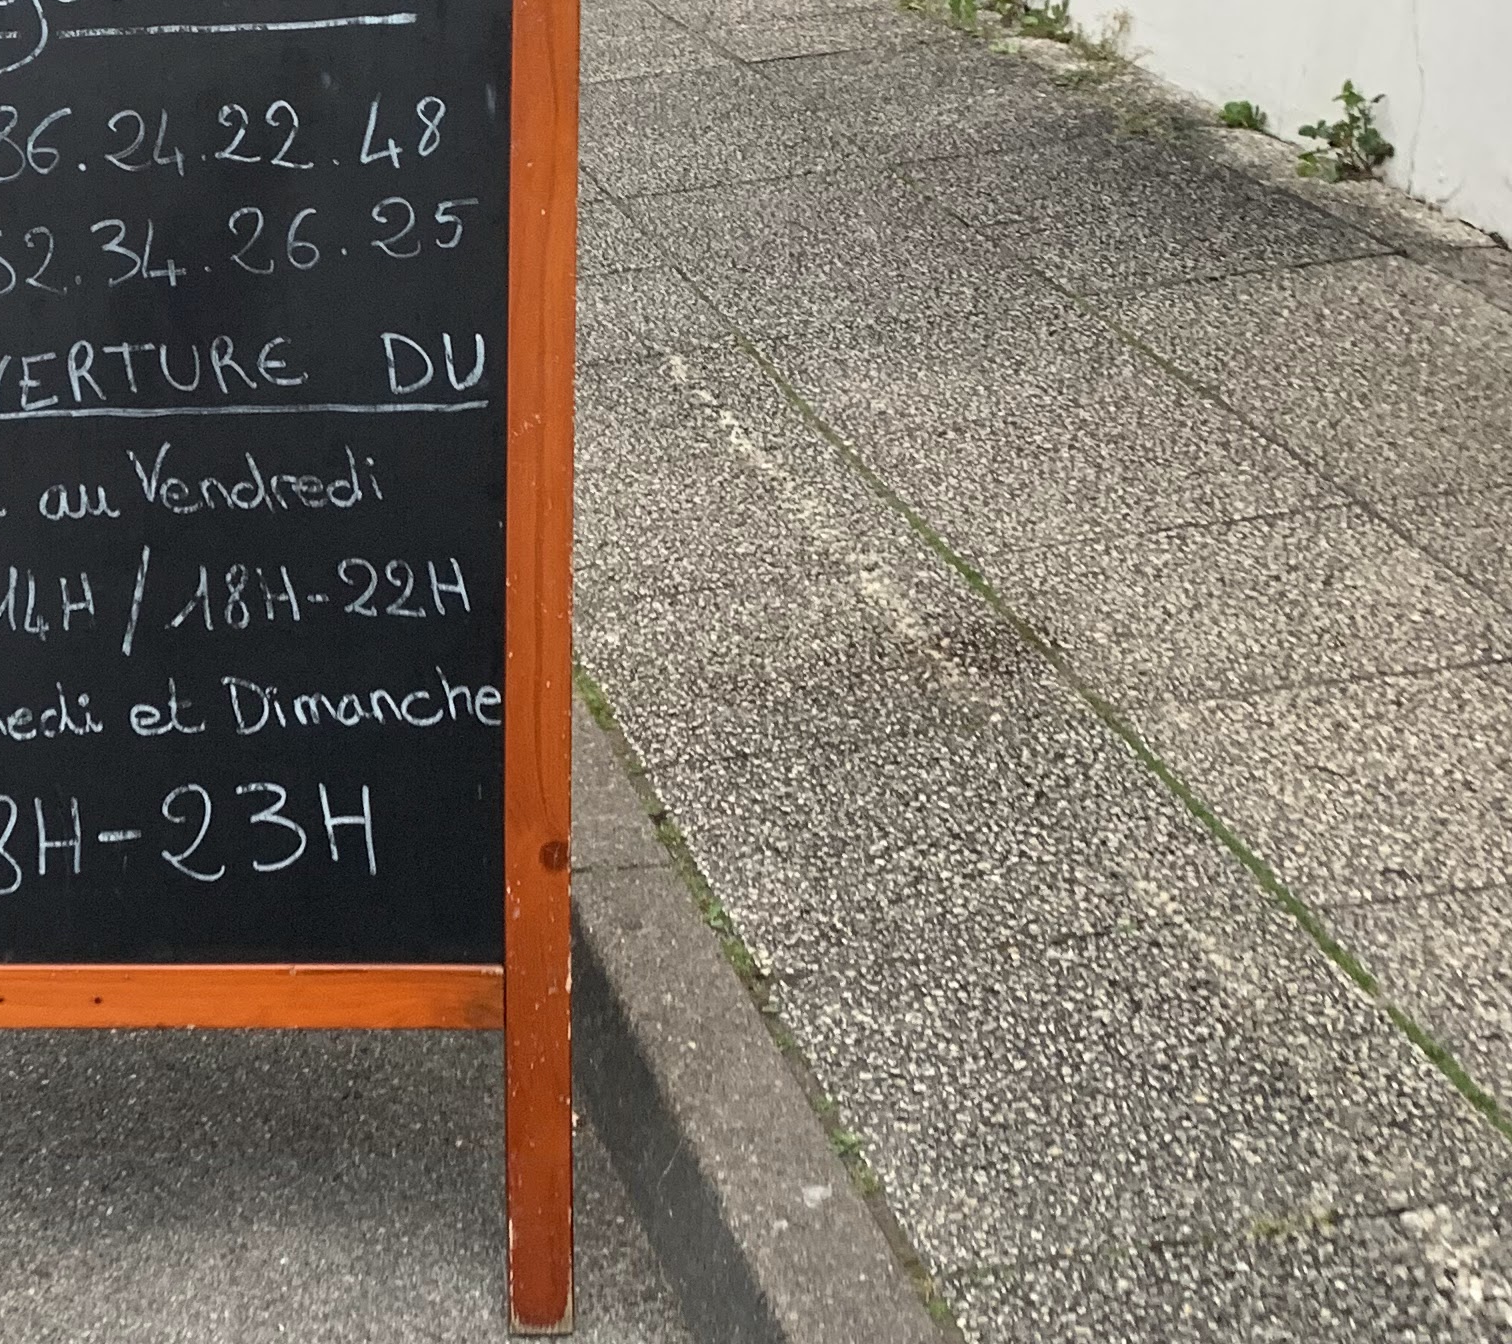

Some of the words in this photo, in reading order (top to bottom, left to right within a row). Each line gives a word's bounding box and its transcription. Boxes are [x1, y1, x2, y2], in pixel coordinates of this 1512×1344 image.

[380, 332, 486, 396] DU
[38, 483, 121, 521] au
[126, 441, 385, 514] Vendredi
[129, 677, 206, 737] et
[221, 666, 502, 736] Dimanche
